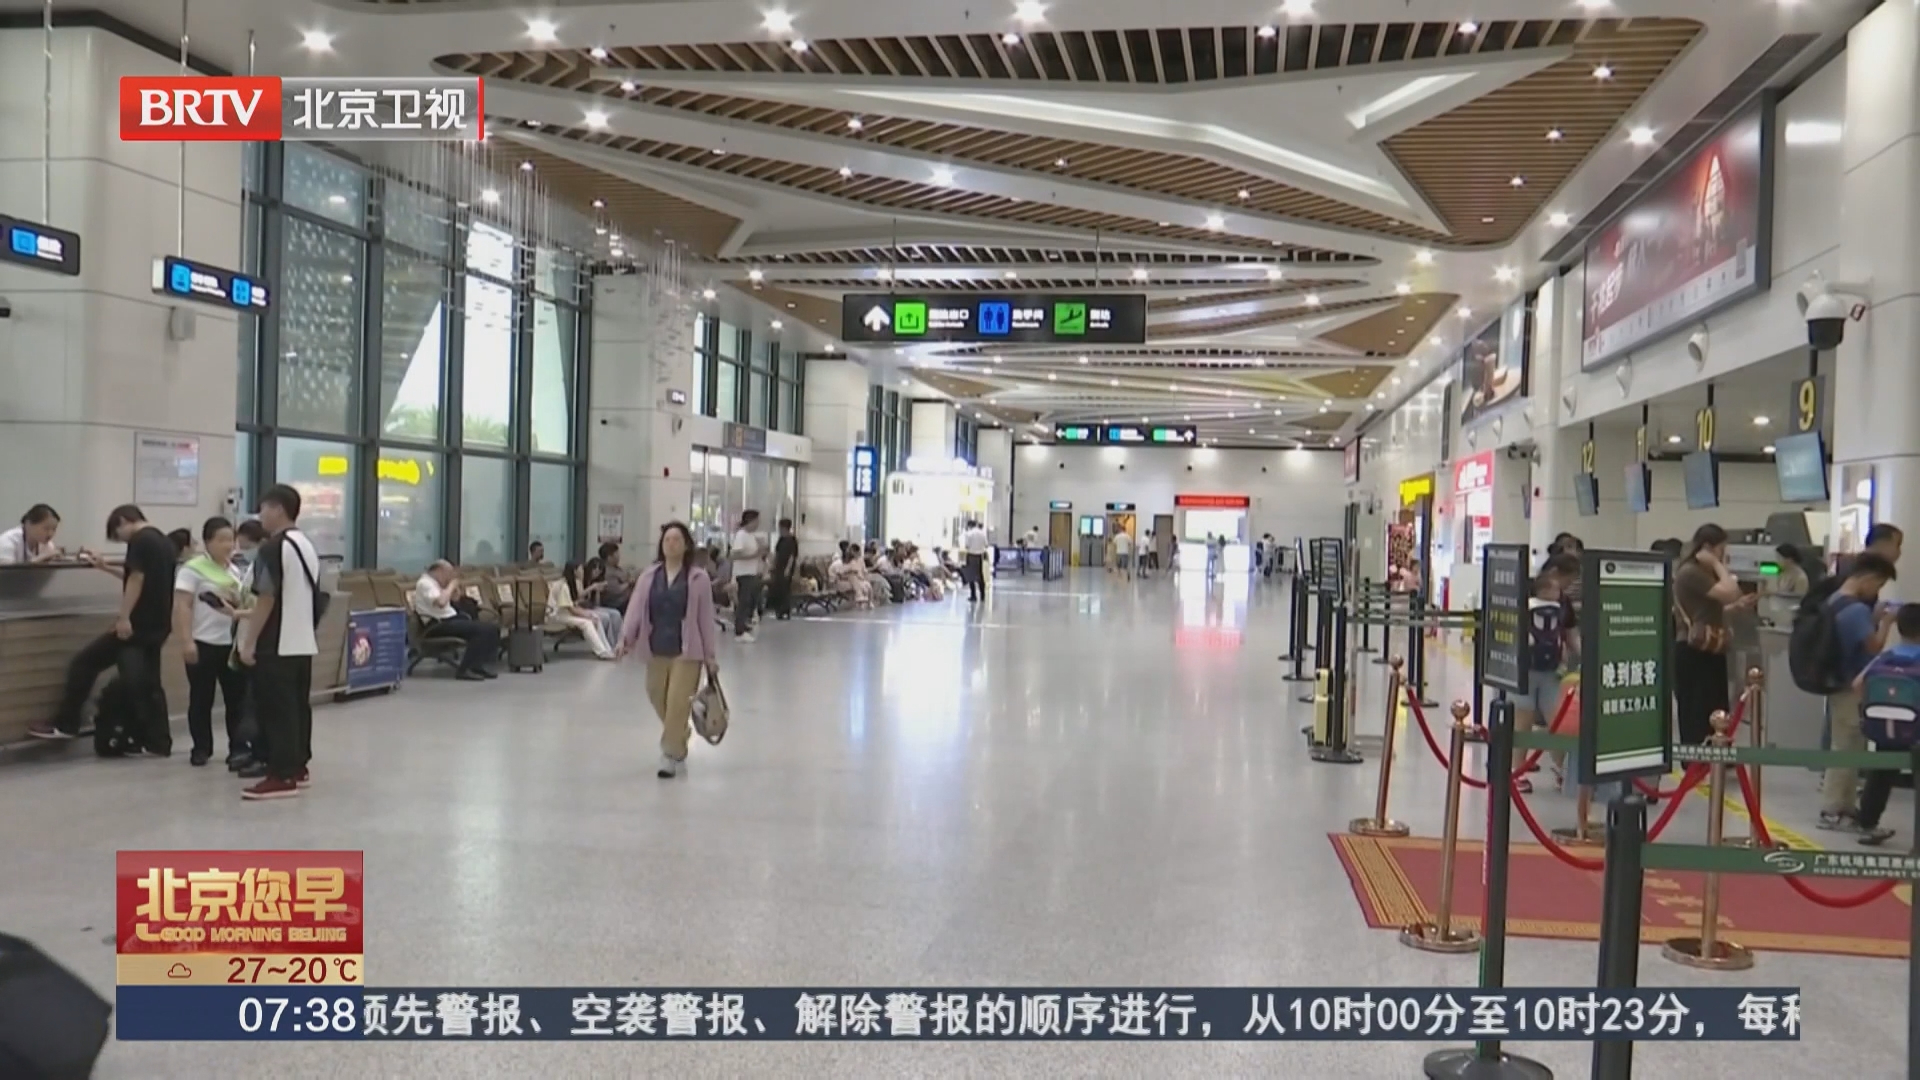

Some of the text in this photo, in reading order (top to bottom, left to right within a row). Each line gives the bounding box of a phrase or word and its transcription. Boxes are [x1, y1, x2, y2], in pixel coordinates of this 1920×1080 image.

[1799, 379, 1816, 431] 9
[1696, 408, 1715, 451] 10
[1582, 441, 1595, 474] 12
[1602, 658, 1657, 689] 晚到旅客
[1814, 854, 1920, 869] 广东机场集团惠州
